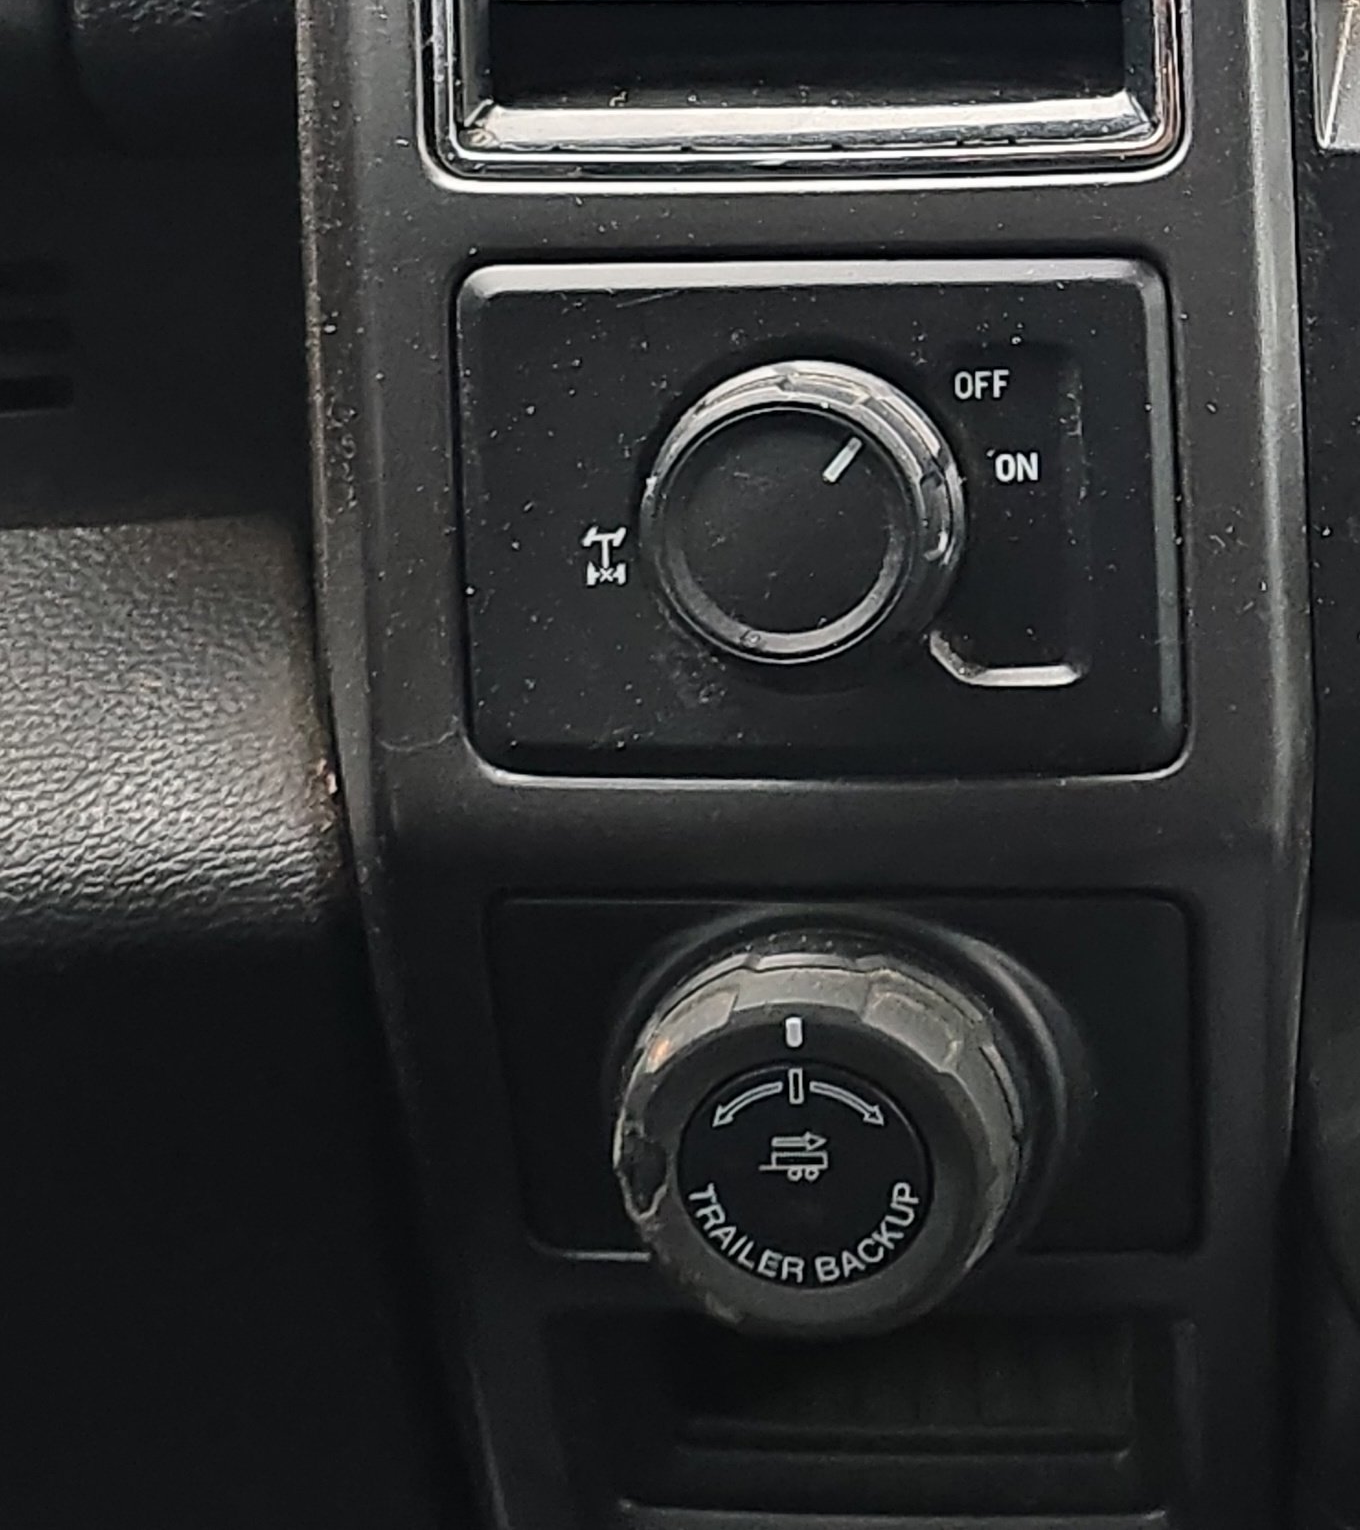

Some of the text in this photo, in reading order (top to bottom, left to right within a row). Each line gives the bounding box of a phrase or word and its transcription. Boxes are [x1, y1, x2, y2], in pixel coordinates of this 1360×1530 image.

[954, 369, 1009, 400] OFF
[995, 452, 1038, 482] ON
[688, 1182, 919, 1283] TRAILER BACKUP
